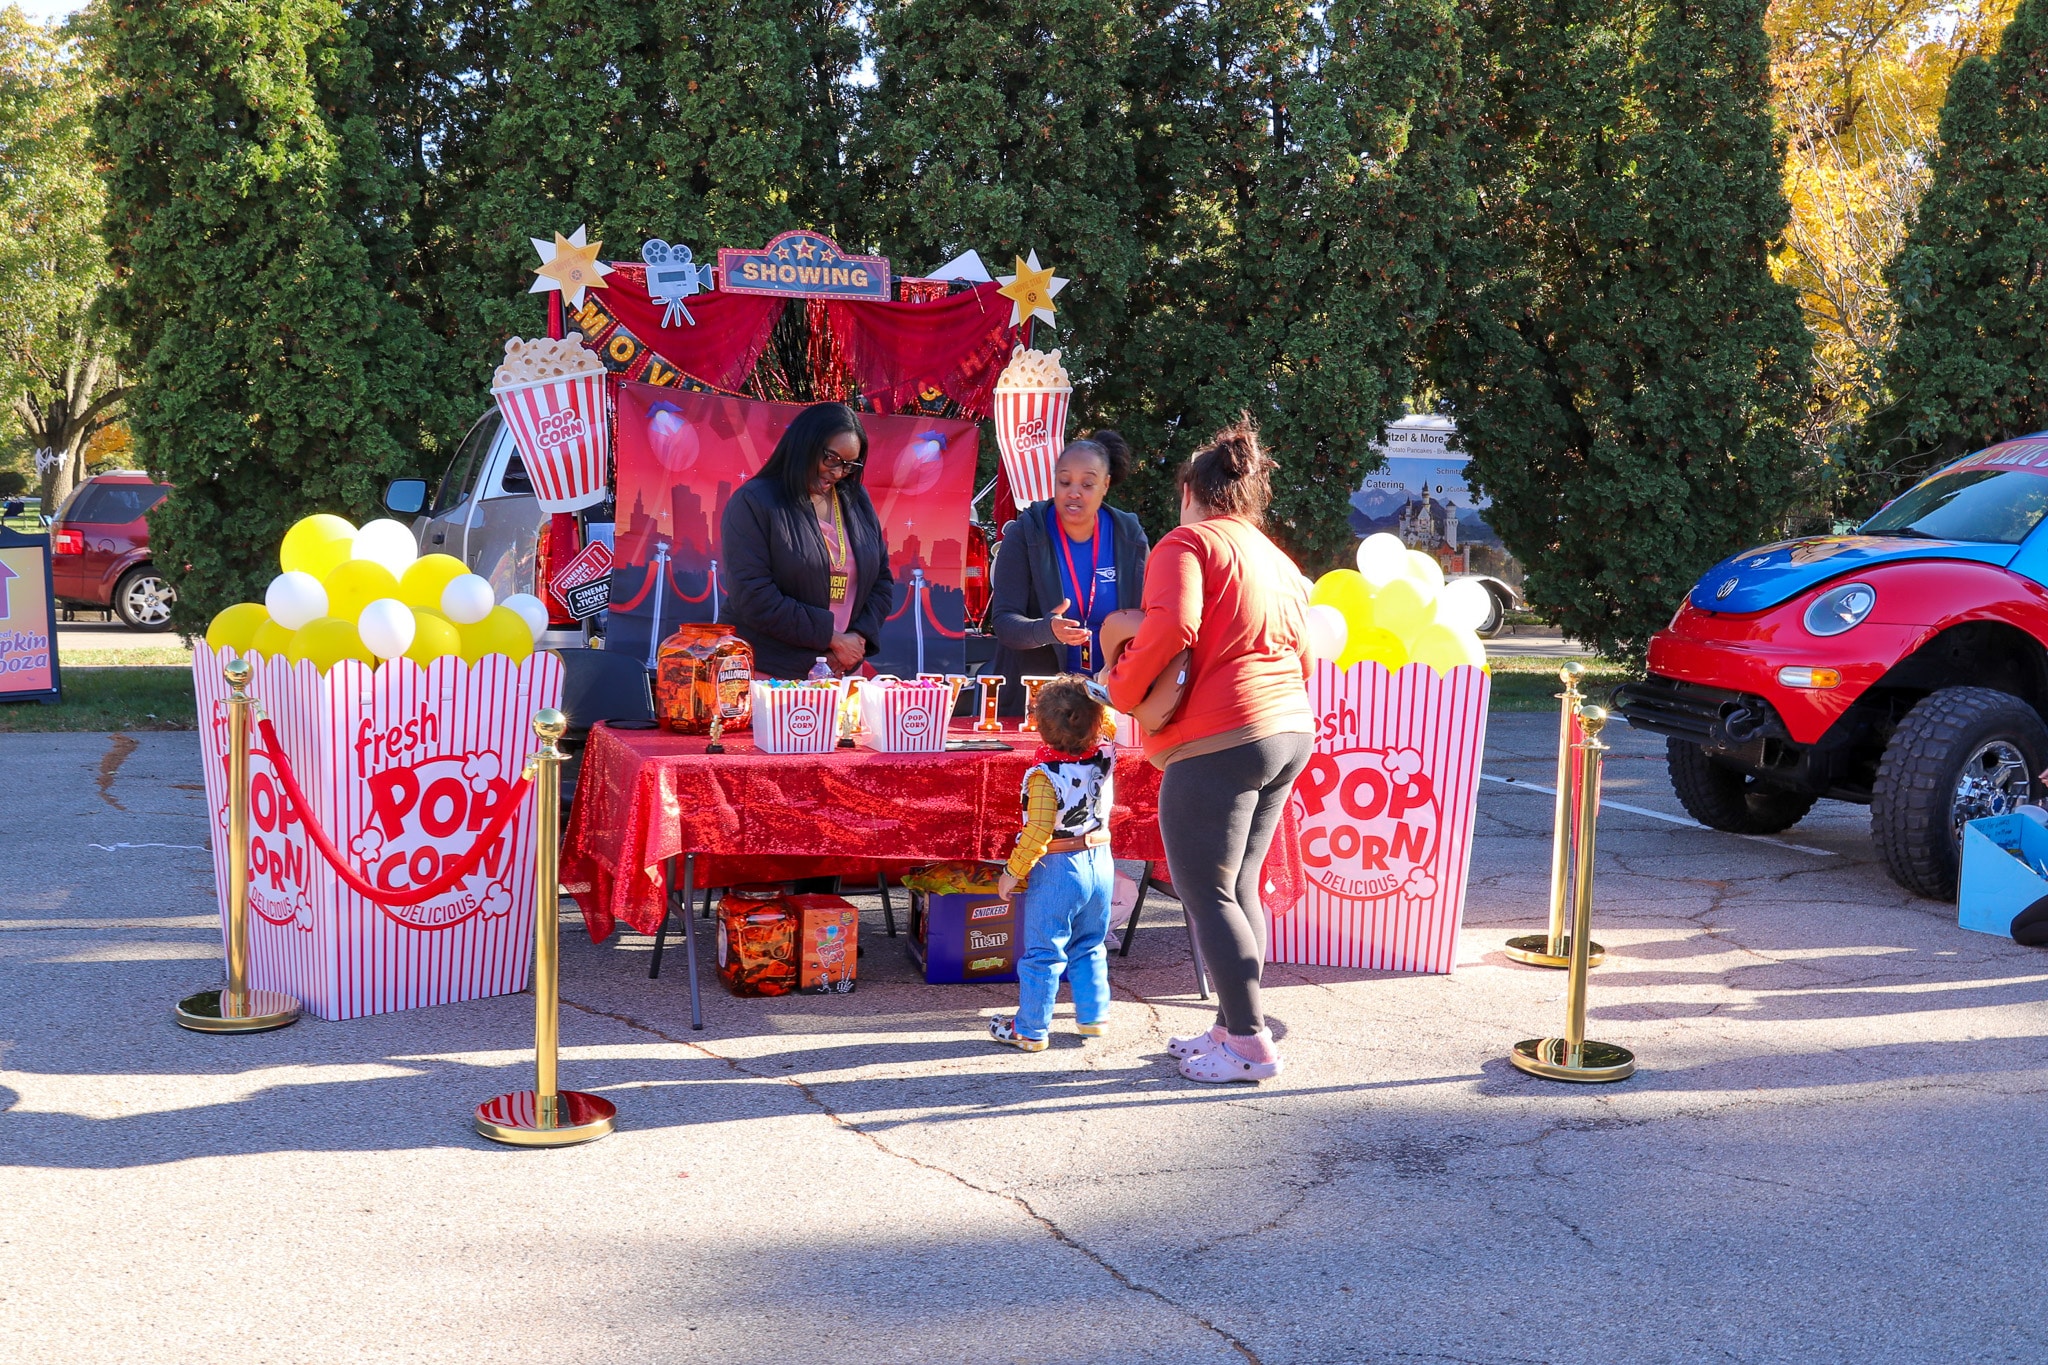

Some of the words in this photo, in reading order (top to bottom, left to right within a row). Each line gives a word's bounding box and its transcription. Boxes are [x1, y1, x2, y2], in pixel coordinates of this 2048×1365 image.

[743, 263, 868, 287] SHOWING
[541, 411, 573, 433] POP
[1019, 421, 1042, 438] POP
[539, 421, 582, 447] CORN
[1016, 432, 1046, 450] CORN
[1421, 433, 1444, 444] More
[1366, 480, 1405, 490] Catering
[561, 561, 589, 589] CINEMA
[830, 576, 847, 587] VENT
[575, 583, 609, 600] CINEMA
[579, 591, 609, 607] TICKET
[830, 588, 845, 599] TAFF
[792, 721, 813, 729] CORN
[905, 721, 925, 729] CORN
[355, 702, 437, 778] fresh
[1300, 752, 1433, 820] POP
[367, 766, 510, 842] POP
[1301, 821, 1428, 871] CORN
[249, 836, 303, 893] ORN
[1320, 869, 1398, 895] DELICIOUS
[252, 887, 293, 918] DELICIOUS
[400, 893, 476, 924] DELICIOUS
[973, 905, 1008, 918] SNICKERS
